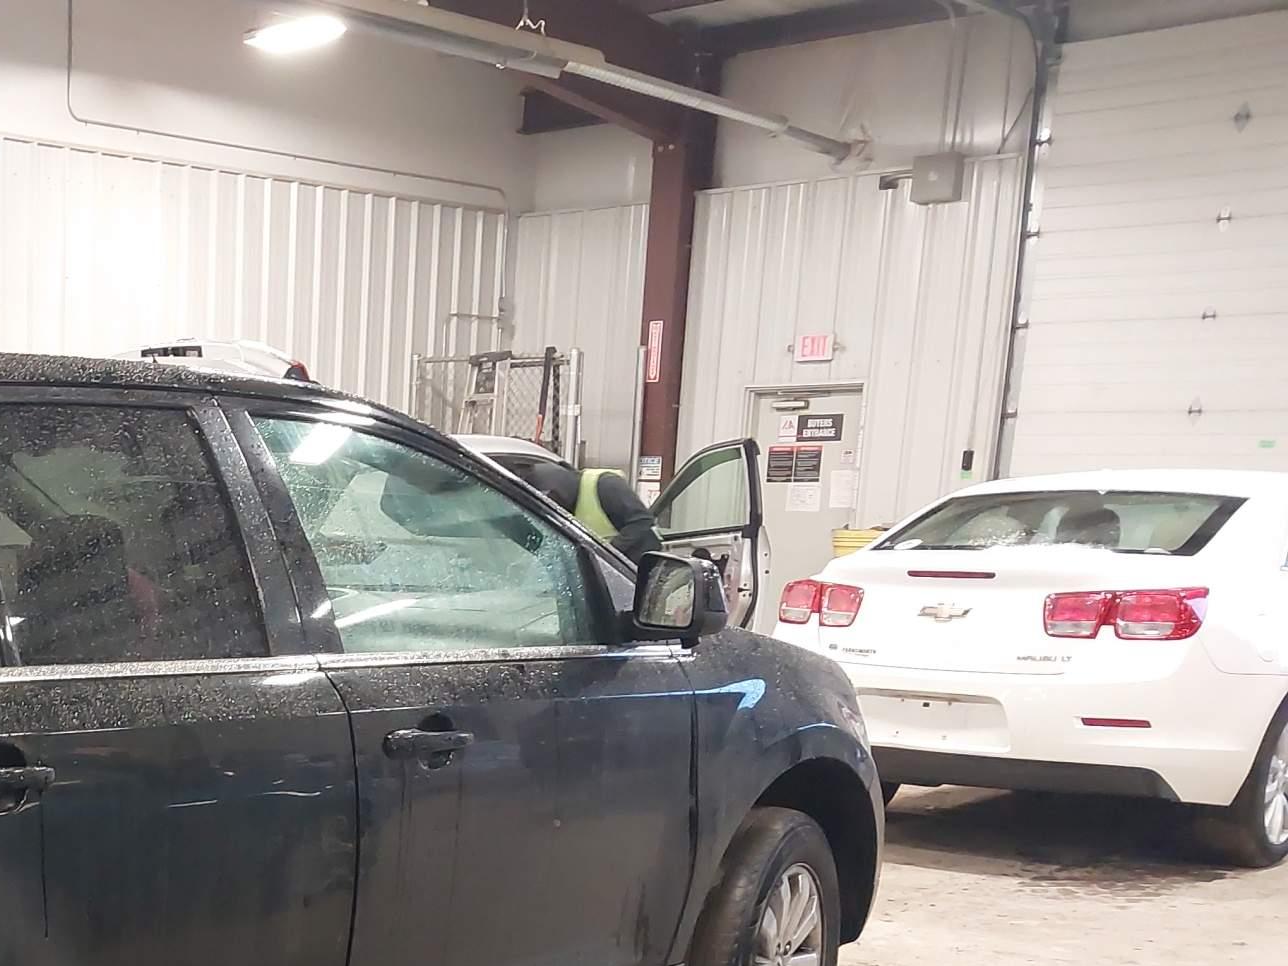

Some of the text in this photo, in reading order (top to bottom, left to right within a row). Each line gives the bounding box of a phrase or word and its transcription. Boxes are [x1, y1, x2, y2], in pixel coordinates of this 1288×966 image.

[800, 334, 828, 358] EXIT
[807, 418, 833, 428] BUYERS
[802, 428, 836, 438] ENTRANCE
